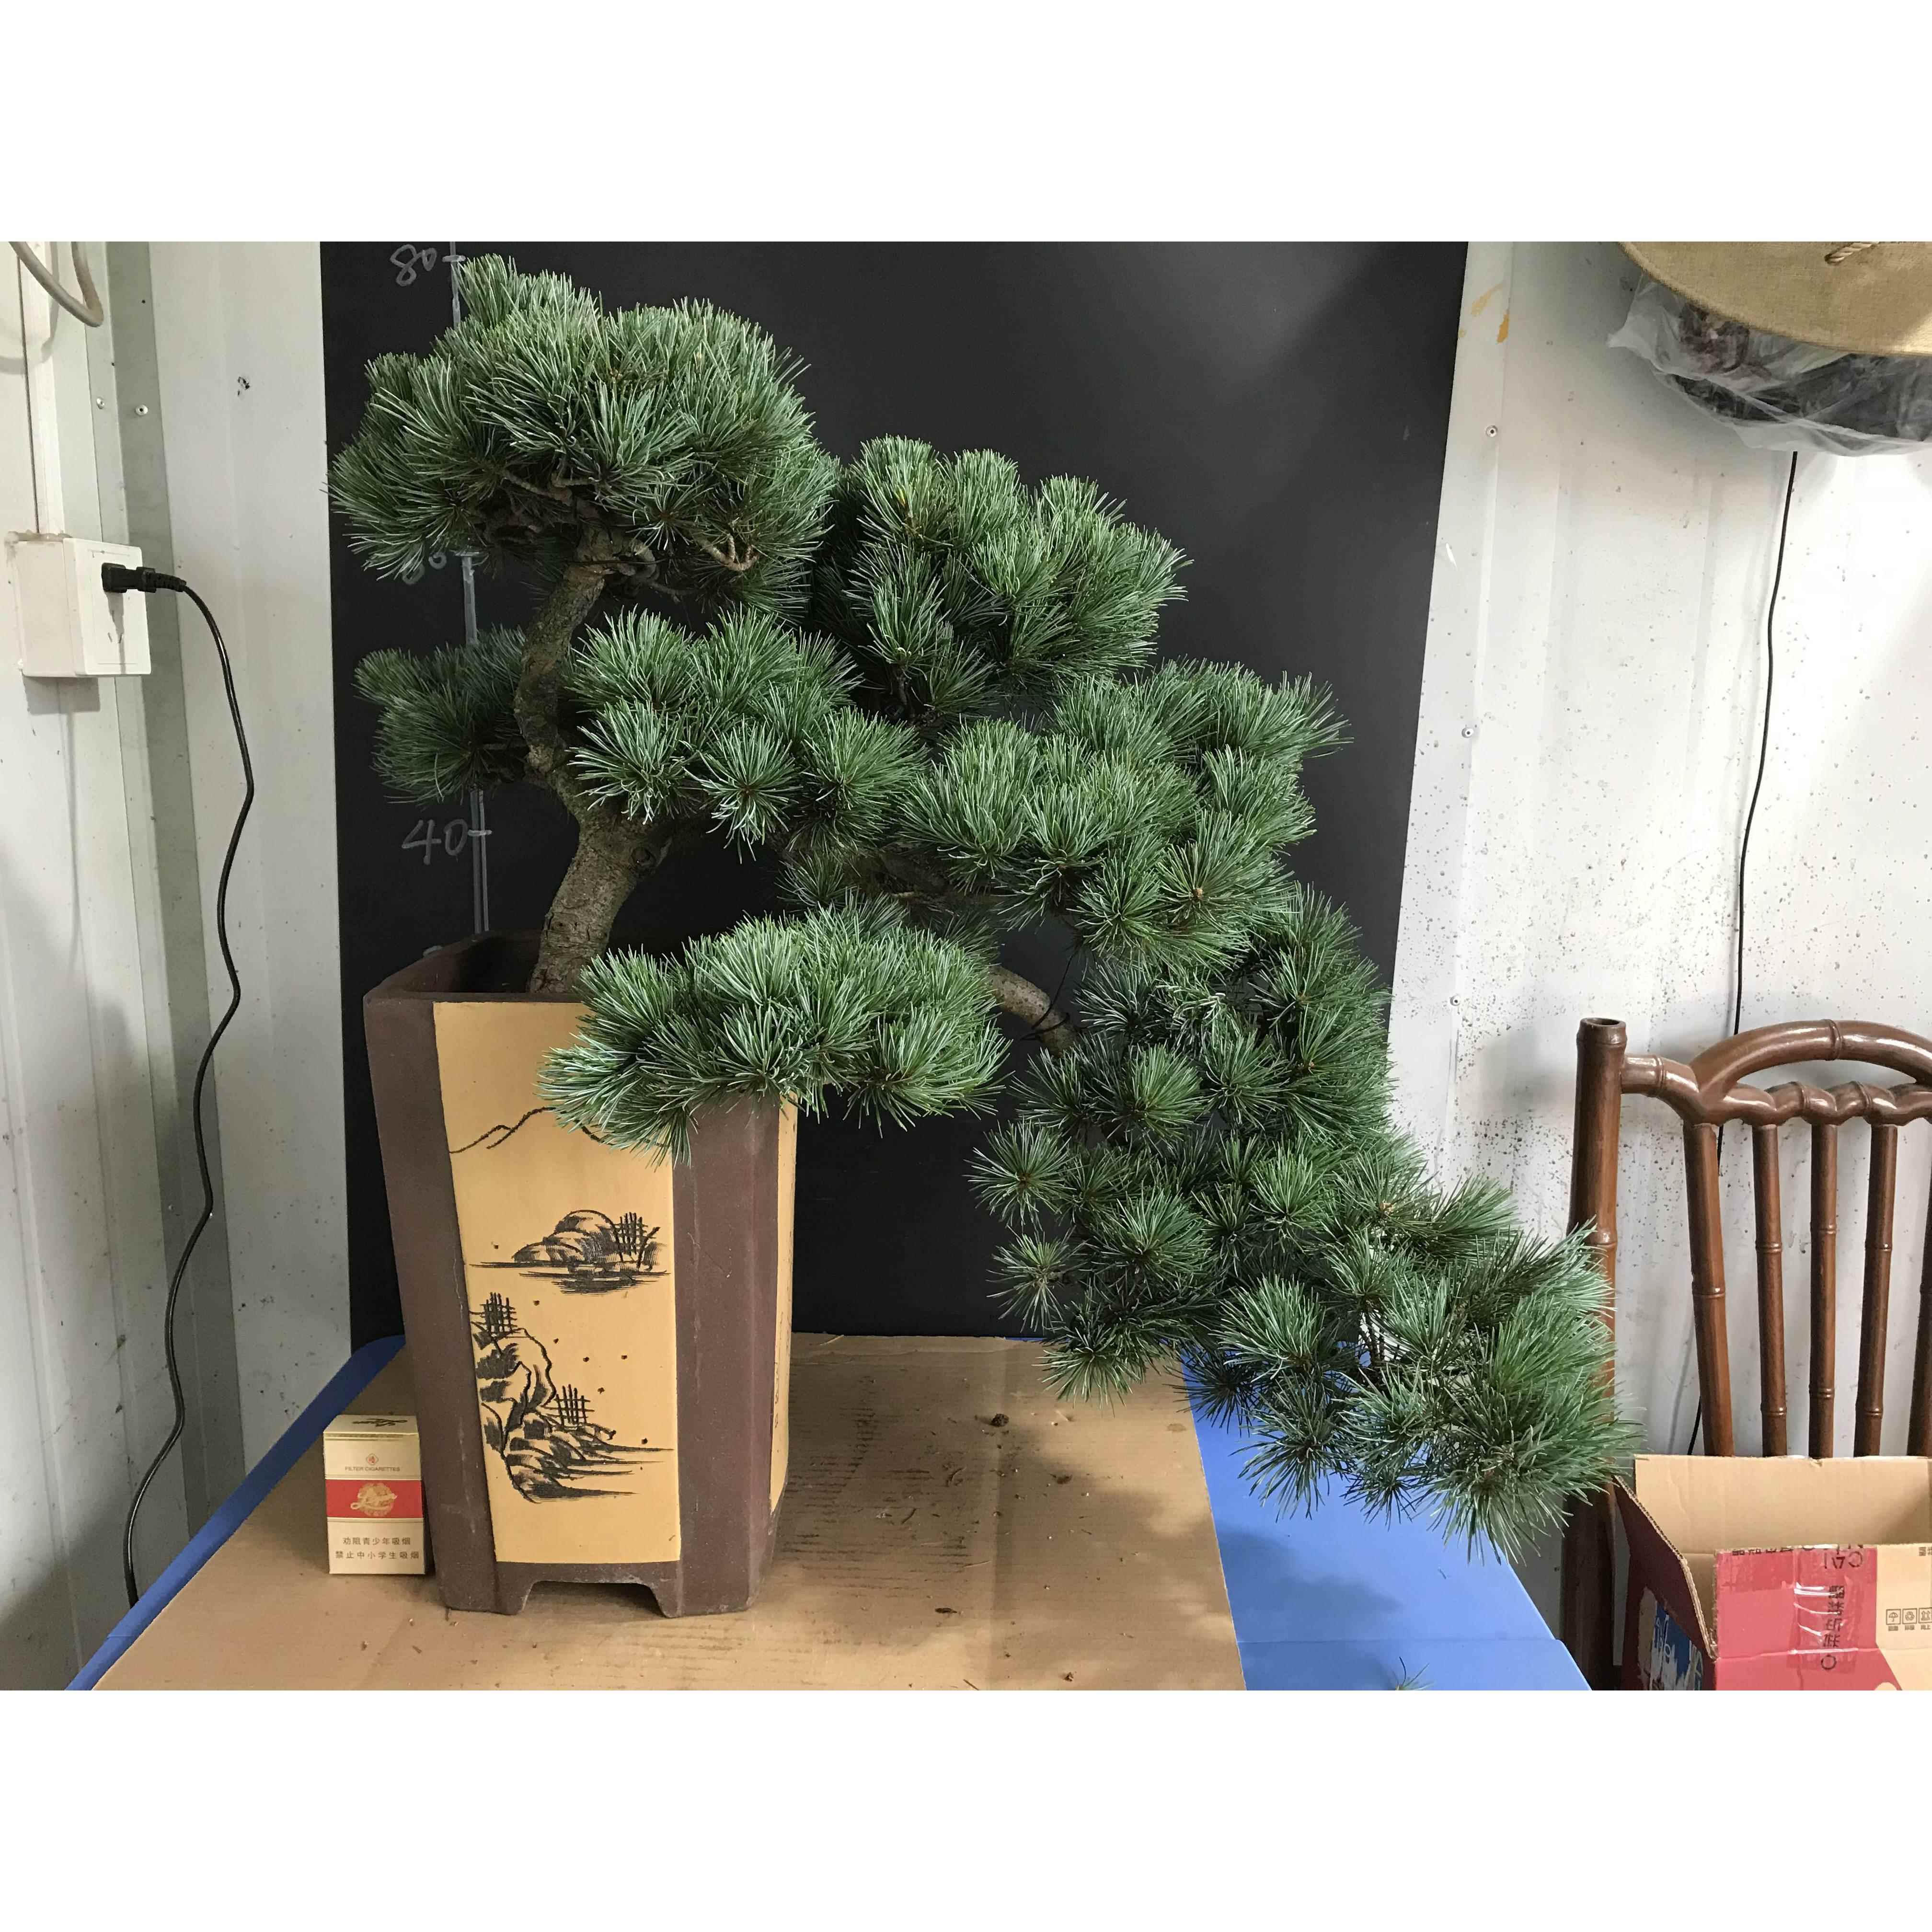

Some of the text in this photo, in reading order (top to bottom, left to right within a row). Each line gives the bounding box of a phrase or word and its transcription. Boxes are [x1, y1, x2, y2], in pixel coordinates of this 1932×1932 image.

[390, 244, 437, 286] 80
[402, 819, 468, 865] 40
[343, 1537, 411, 1546] 劝阻青少年吸烟
[335, 1551, 420, 1560] 禁止中小学生吸烟
